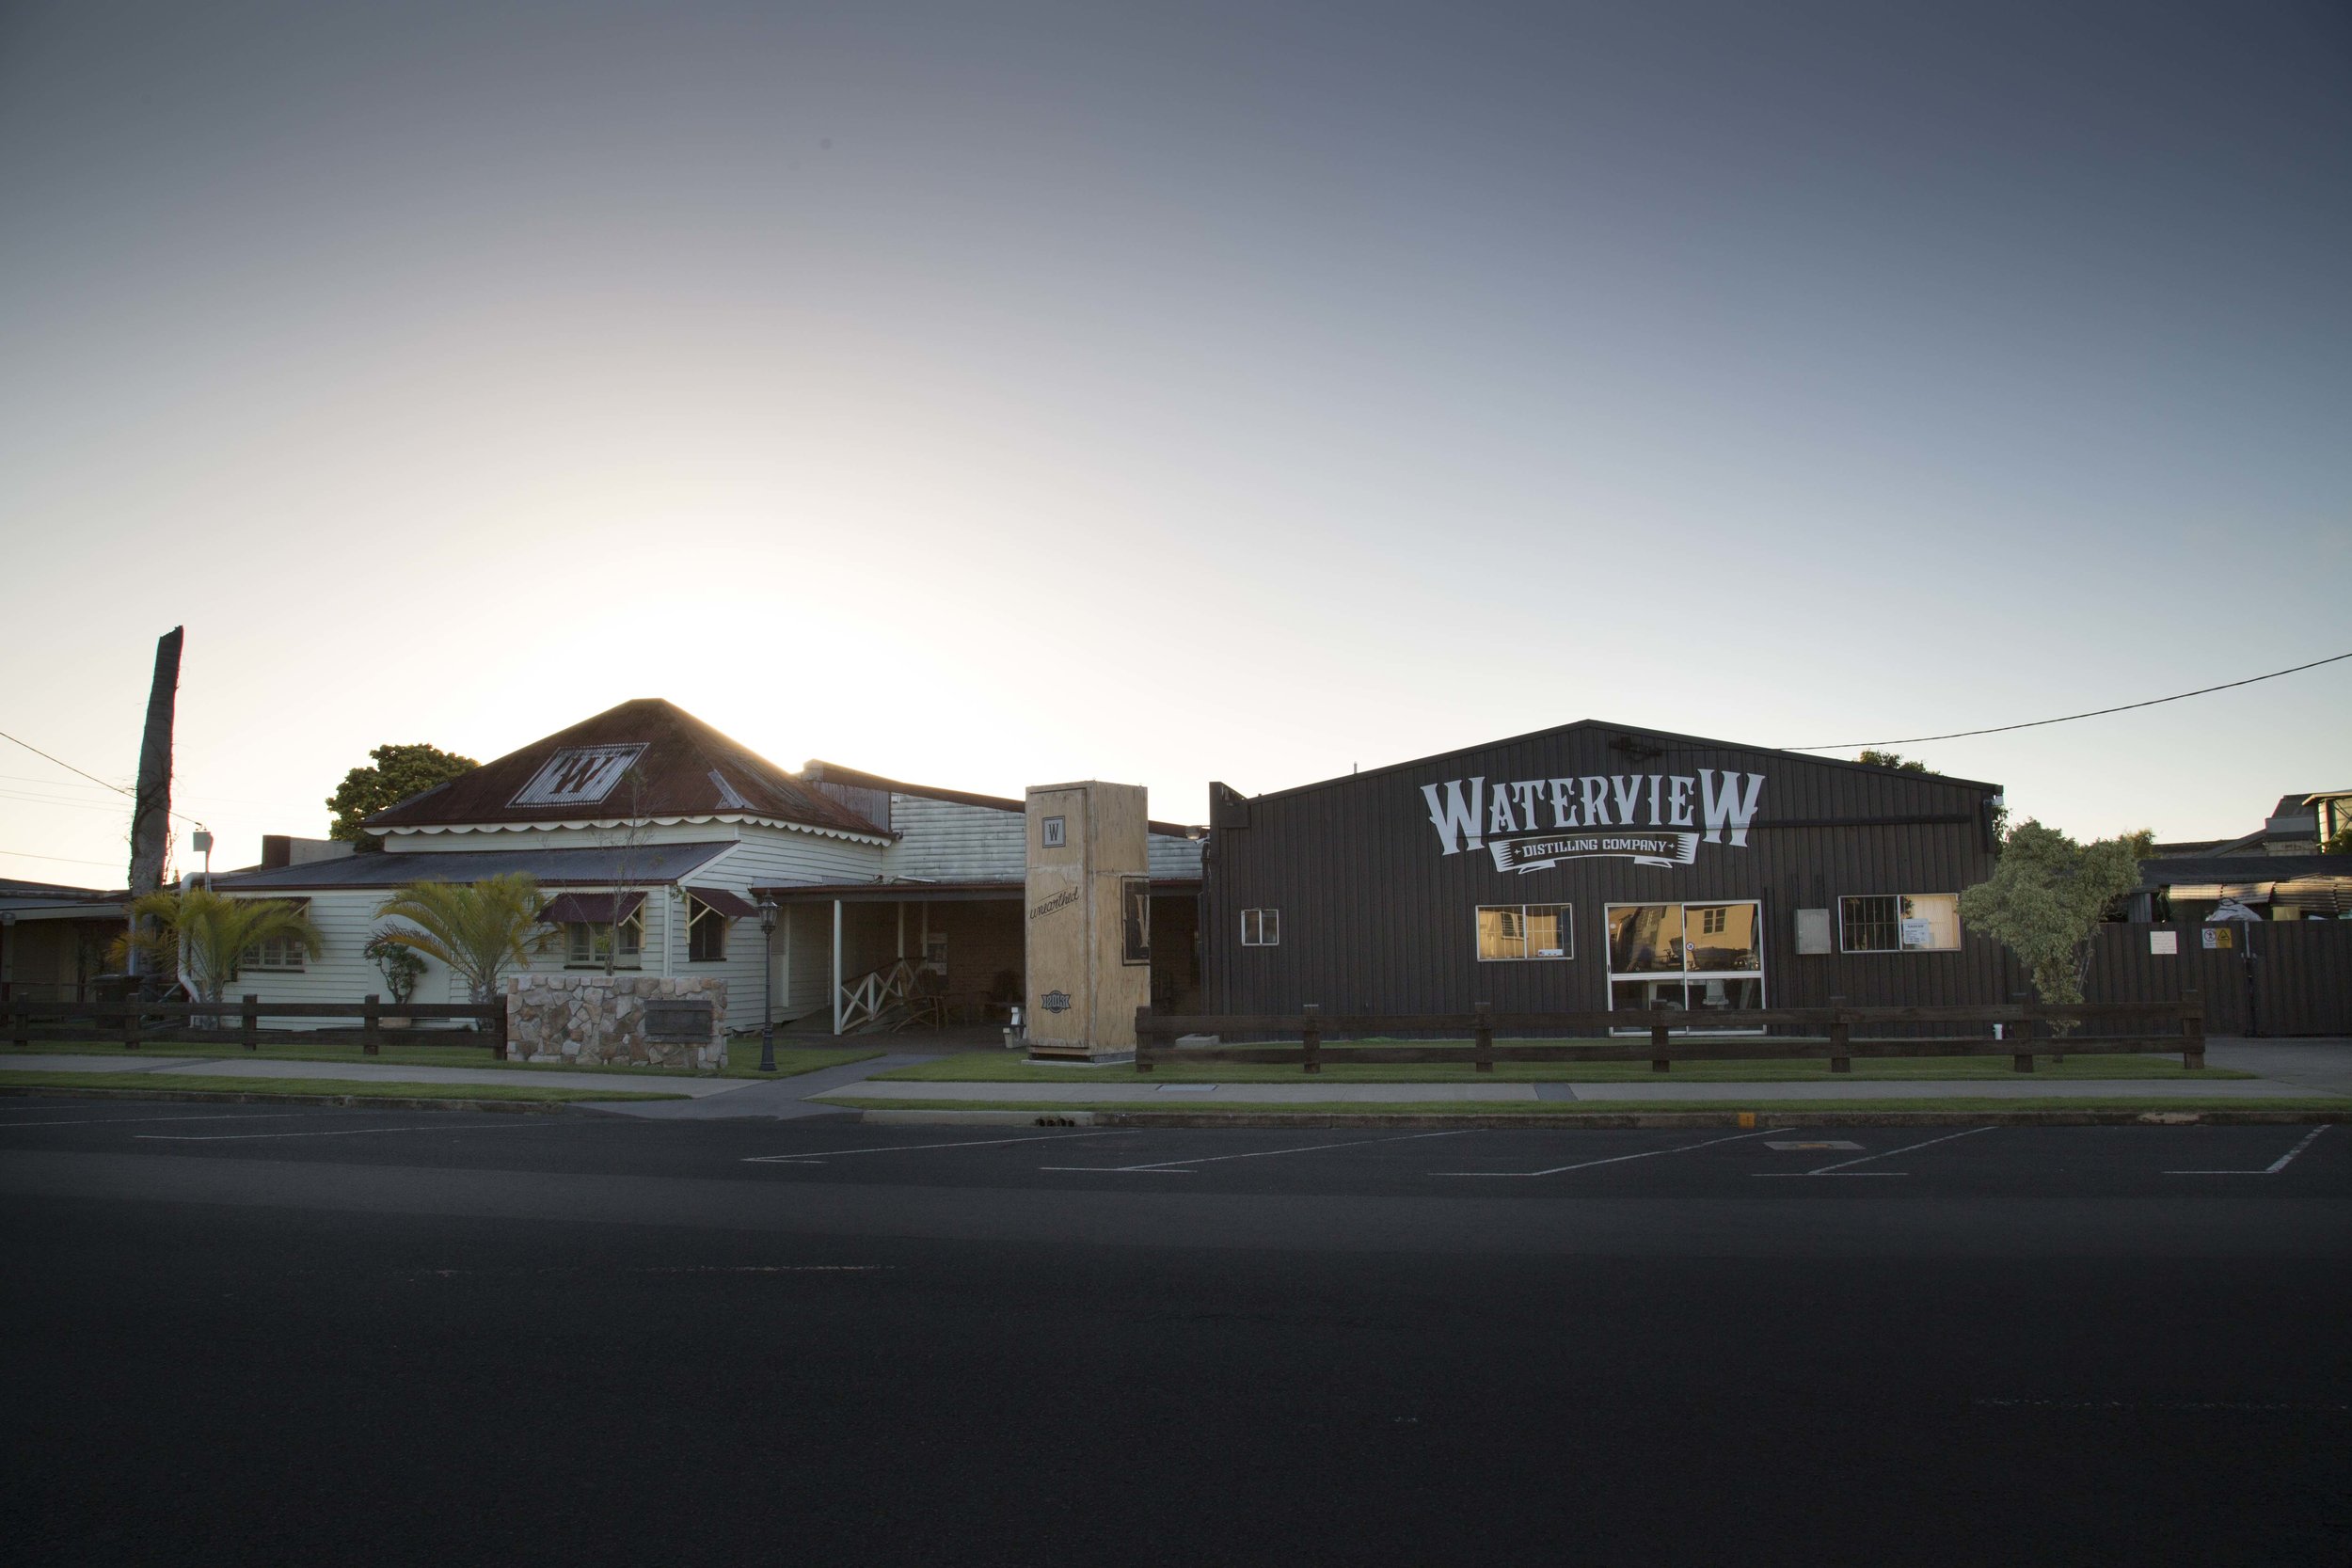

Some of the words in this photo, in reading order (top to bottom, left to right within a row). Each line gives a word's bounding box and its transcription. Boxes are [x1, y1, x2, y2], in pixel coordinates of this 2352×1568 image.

[1420, 768, 1766, 856] WATERVIEW
[1048, 823, 1059, 842] W
[1523, 839, 1598, 857] DISTILLING
[1602, 837, 1667, 853] COMPANY
[1030, 886, 1079, 919] unearthed
